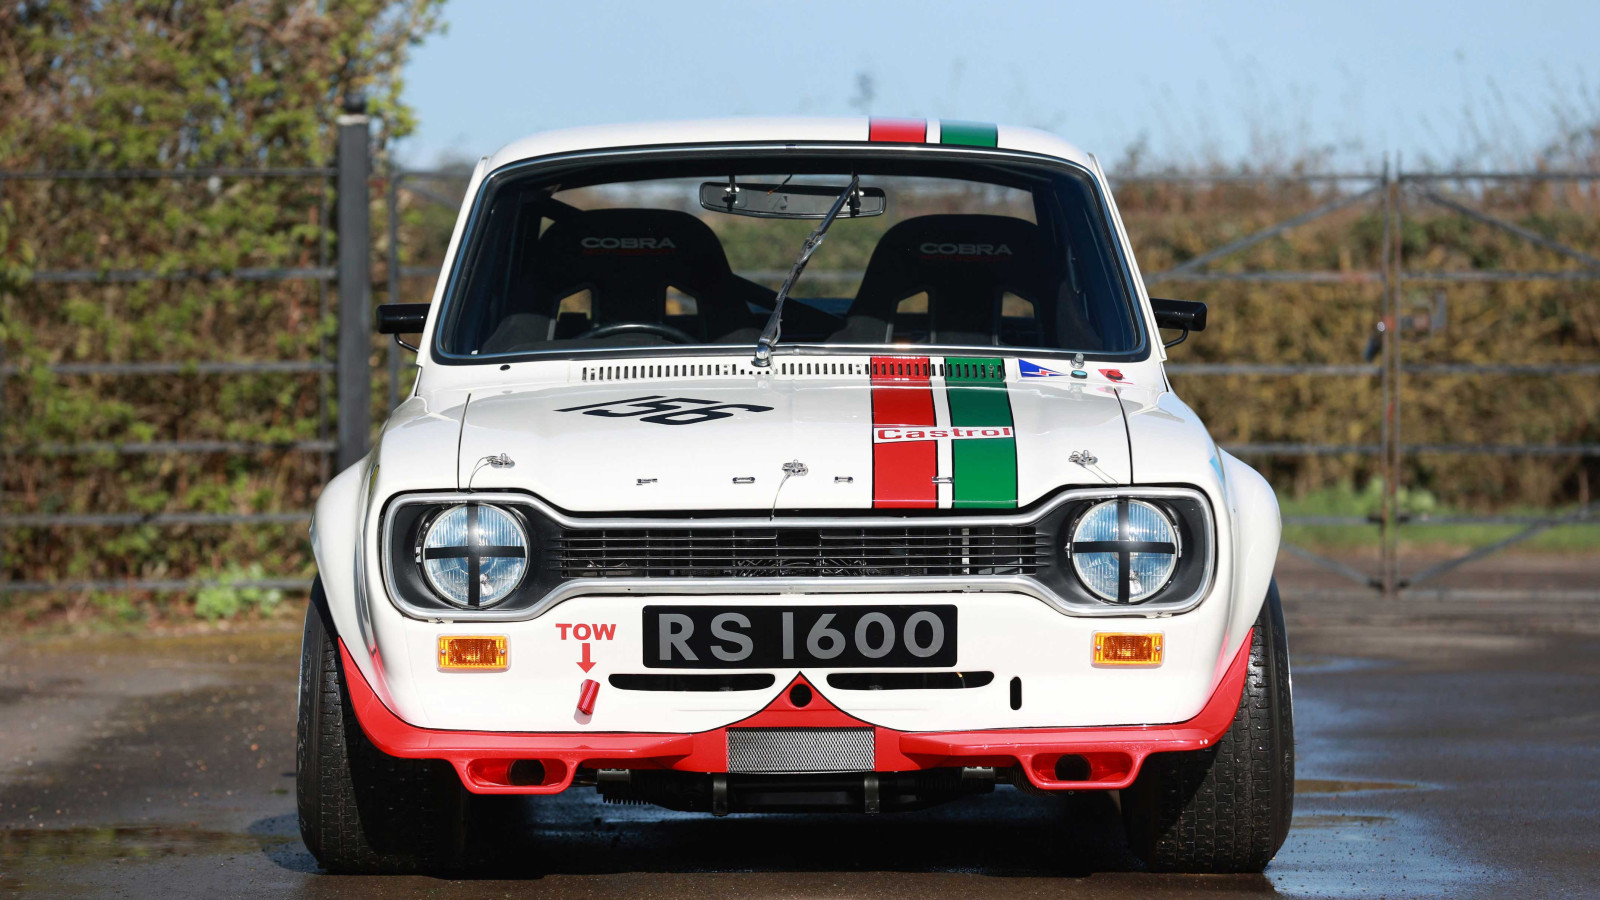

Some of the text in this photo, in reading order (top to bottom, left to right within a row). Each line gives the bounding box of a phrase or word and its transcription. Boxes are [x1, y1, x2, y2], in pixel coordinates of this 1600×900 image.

[581, 237, 676, 248] COBRA
[920, 243, 1013, 255] COBRA
[553, 395, 775, 425] 156
[877, 427, 1011, 440] Castrol
[555, 623, 617, 641] TOW
[658, 610, 945, 662] RS 1600
